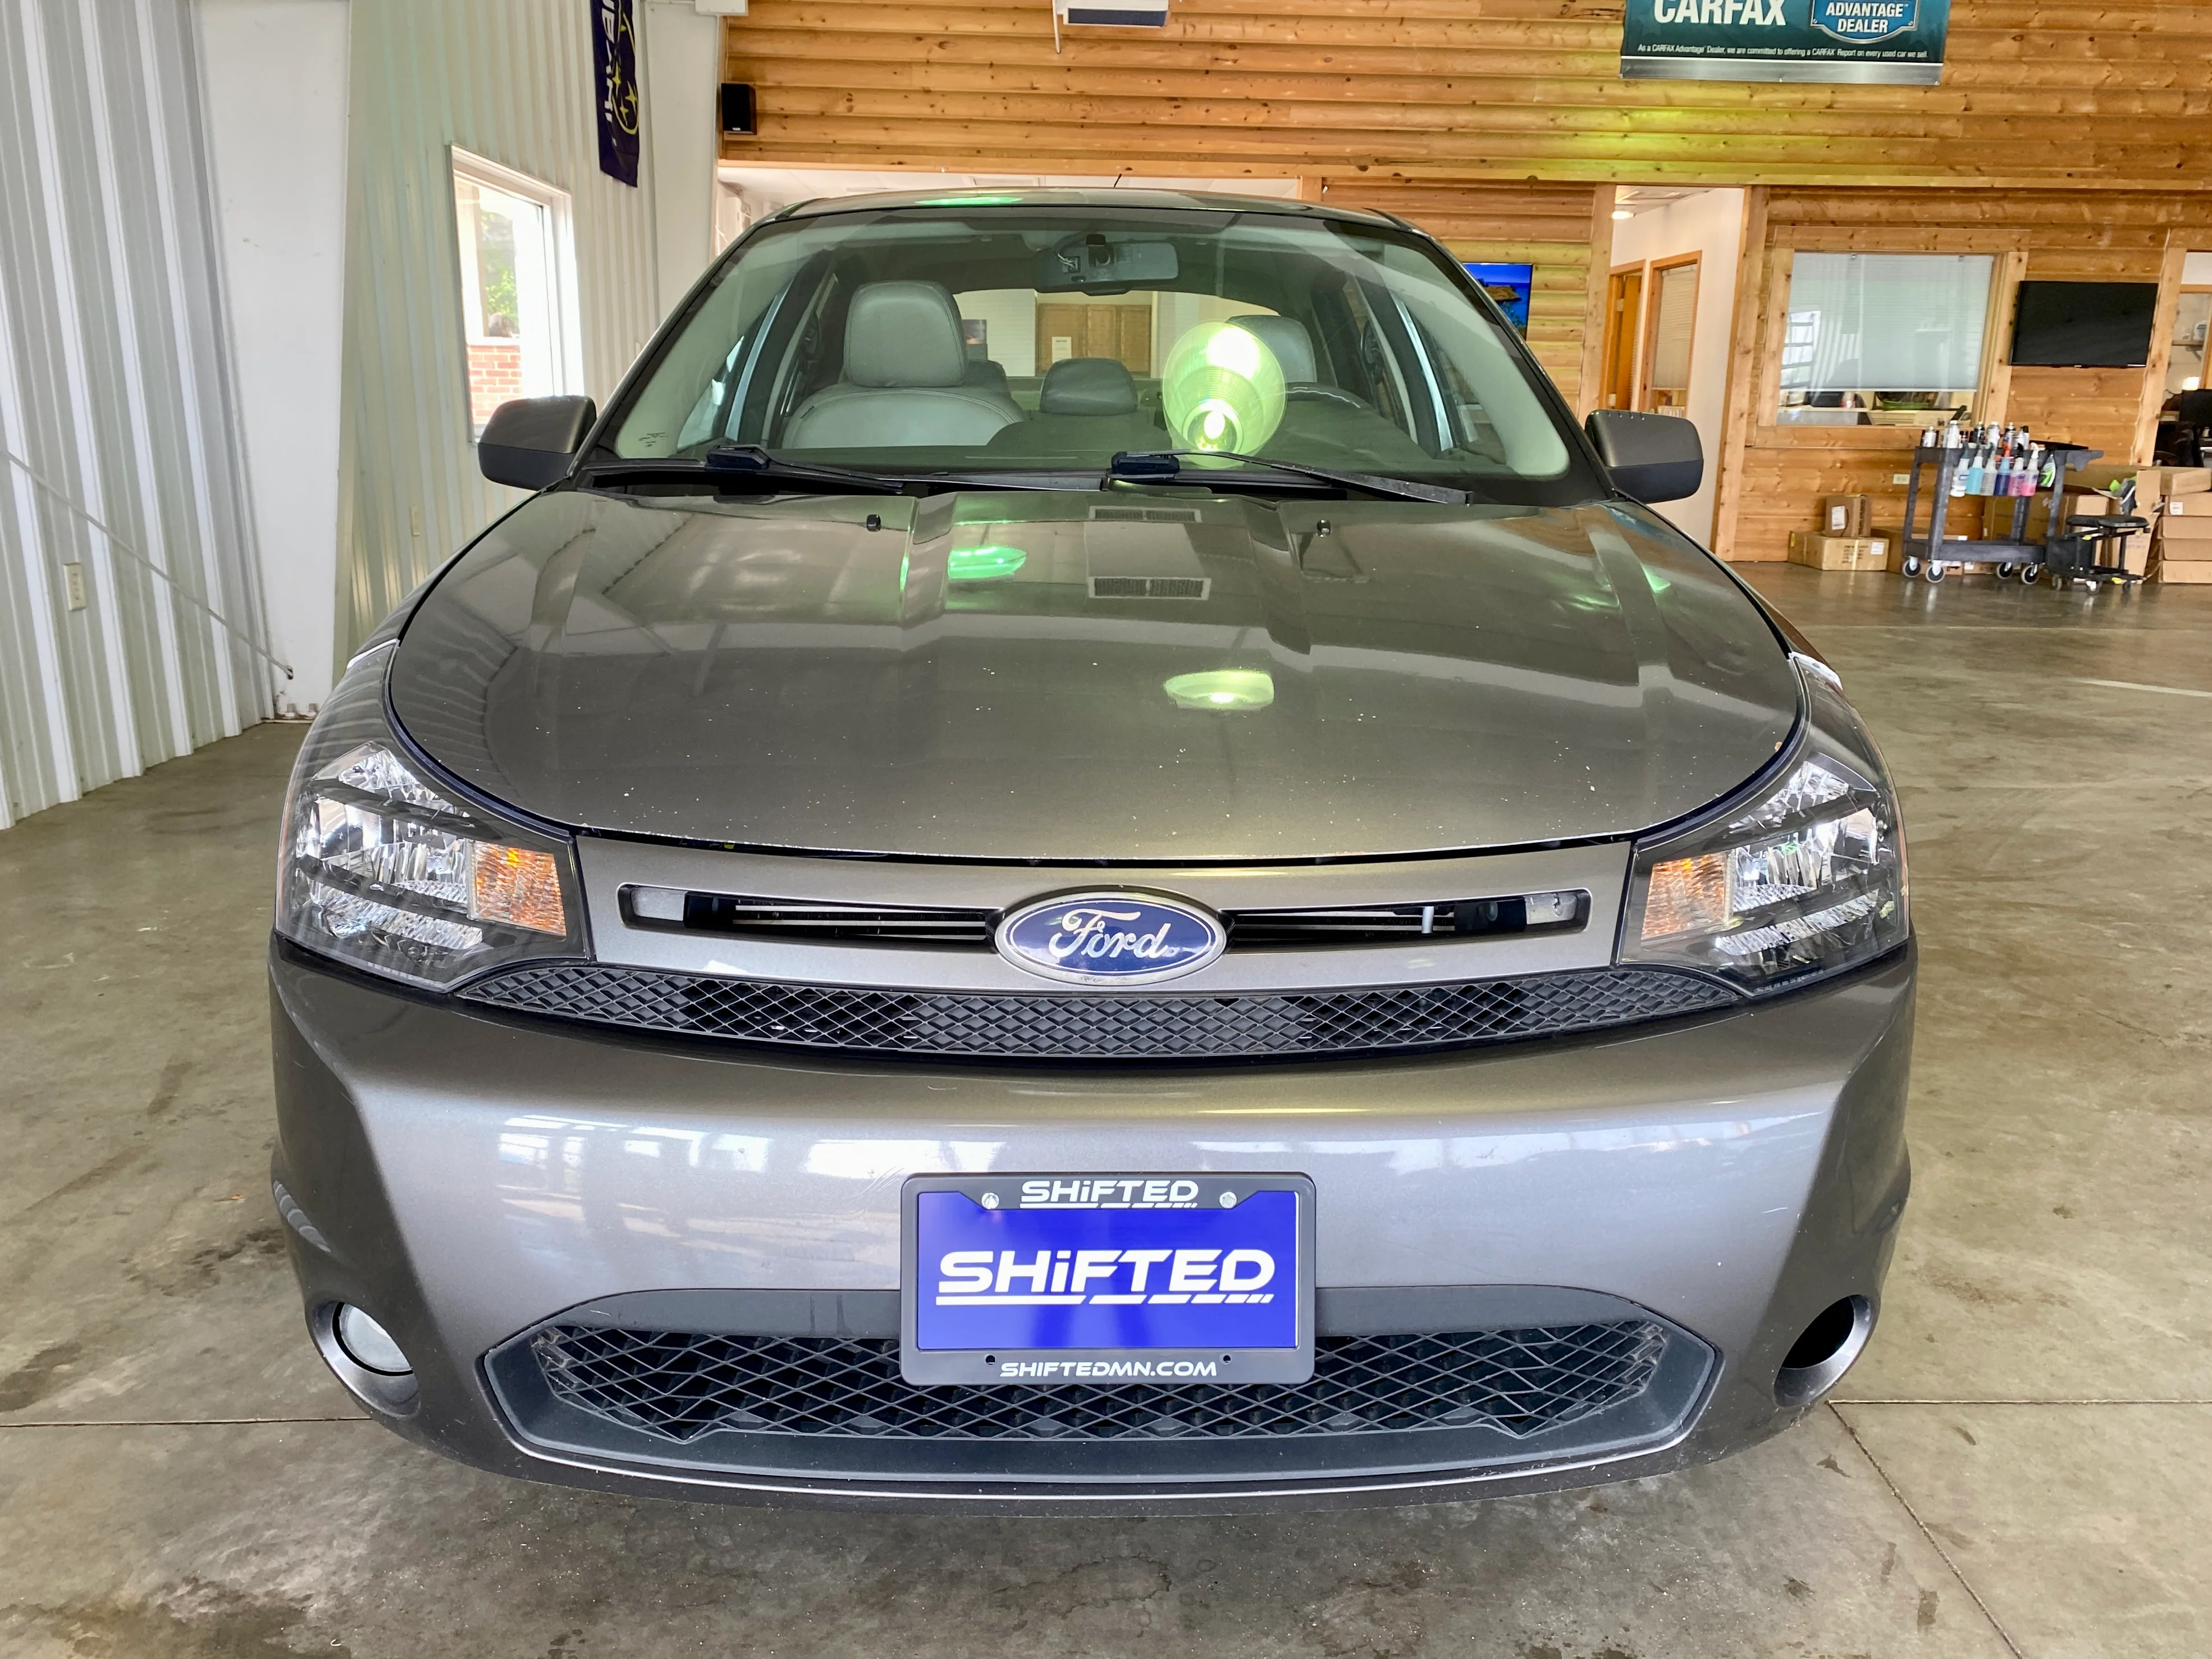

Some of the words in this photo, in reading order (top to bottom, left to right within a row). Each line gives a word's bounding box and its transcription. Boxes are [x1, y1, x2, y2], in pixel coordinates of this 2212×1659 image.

[1654, 0, 1786, 26] CARFAX
[1826, 2, 1904, 17] ADVANTAGE
[1837, 18, 1889, 33] DEALER
[1652, 44, 1675, 52] CARFAX
[1707, 45, 1726, 54] Dealer,
[1784, 48, 1806, 57] offering
[1837, 48, 1856, 57] Report
[1048, 908, 1175, 958] Ford
[1000, 1361, 1217, 1377] SHIFTEDMN.COM
